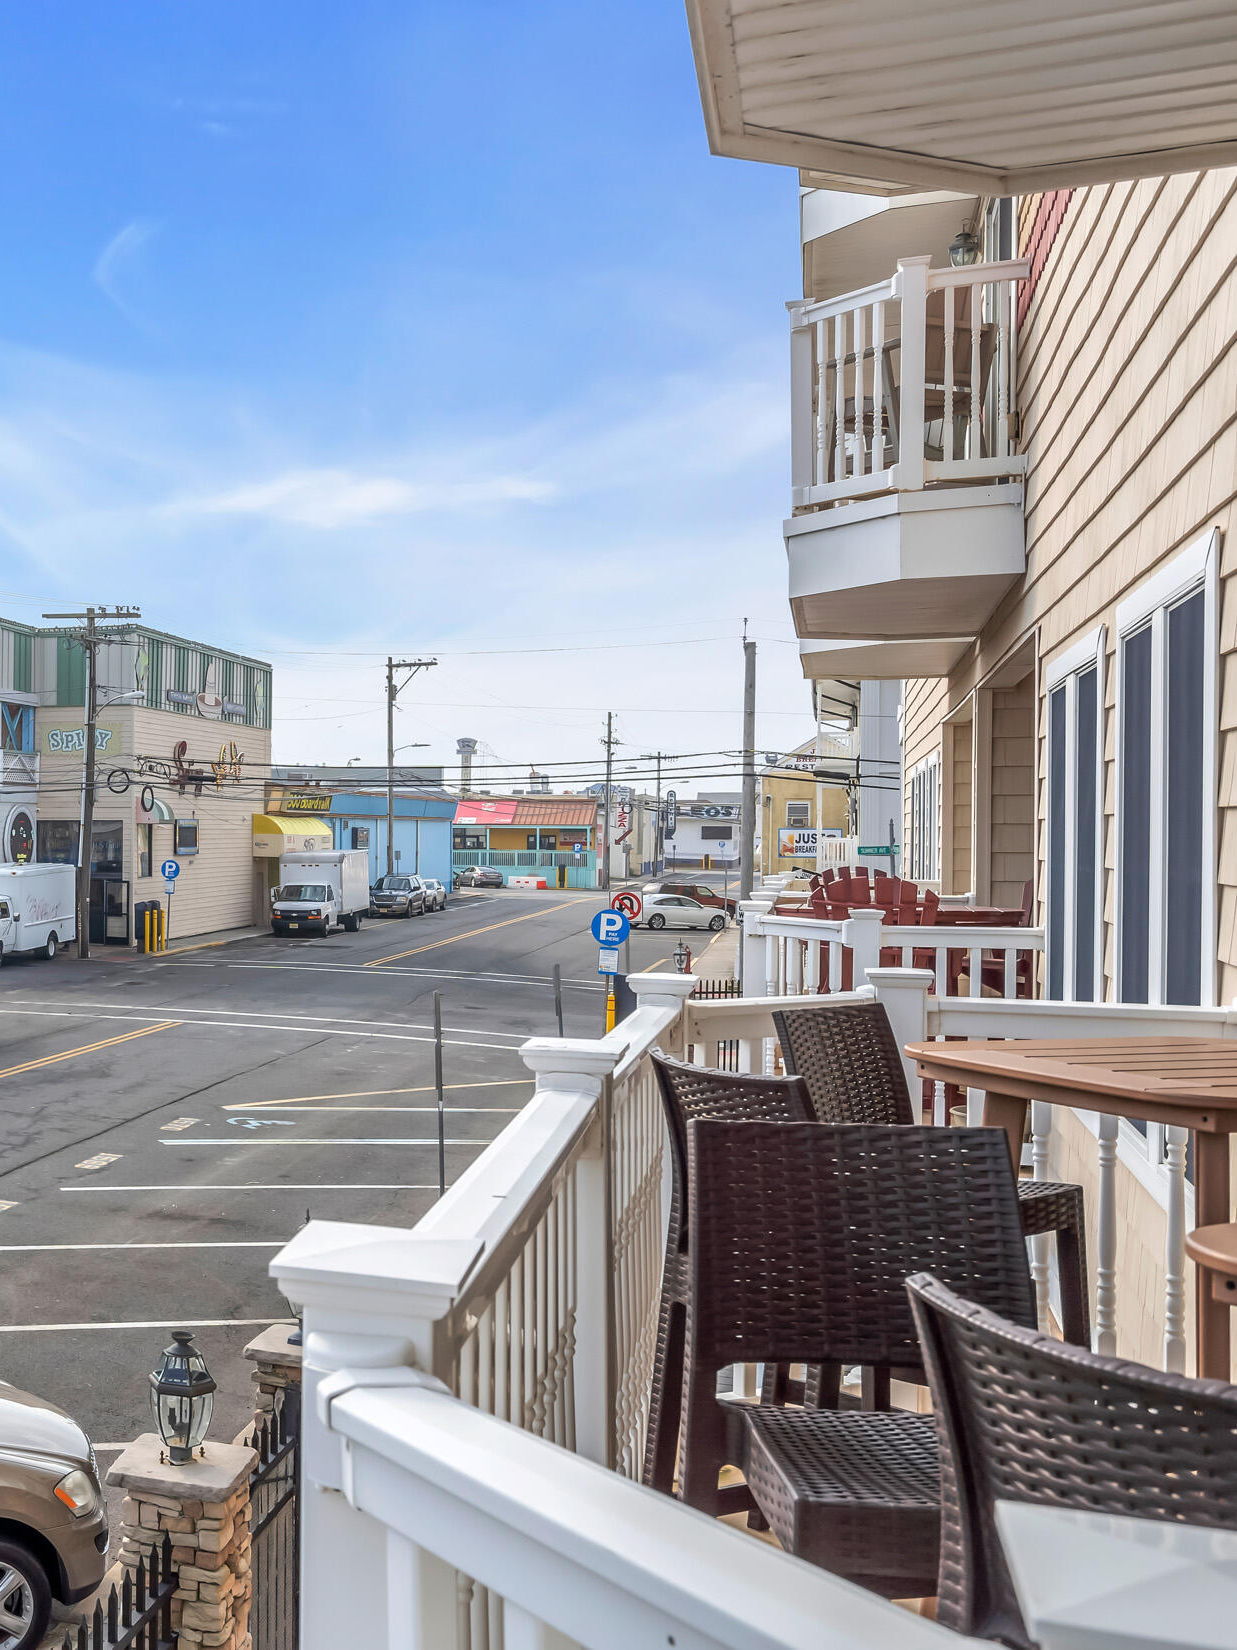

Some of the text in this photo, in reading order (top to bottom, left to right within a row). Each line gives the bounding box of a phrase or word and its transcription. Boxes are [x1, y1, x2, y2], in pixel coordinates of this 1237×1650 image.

[48, 728, 112, 752] SPIY
[794, 845, 817, 854] BREAKF
[599, 913, 622, 940] P
